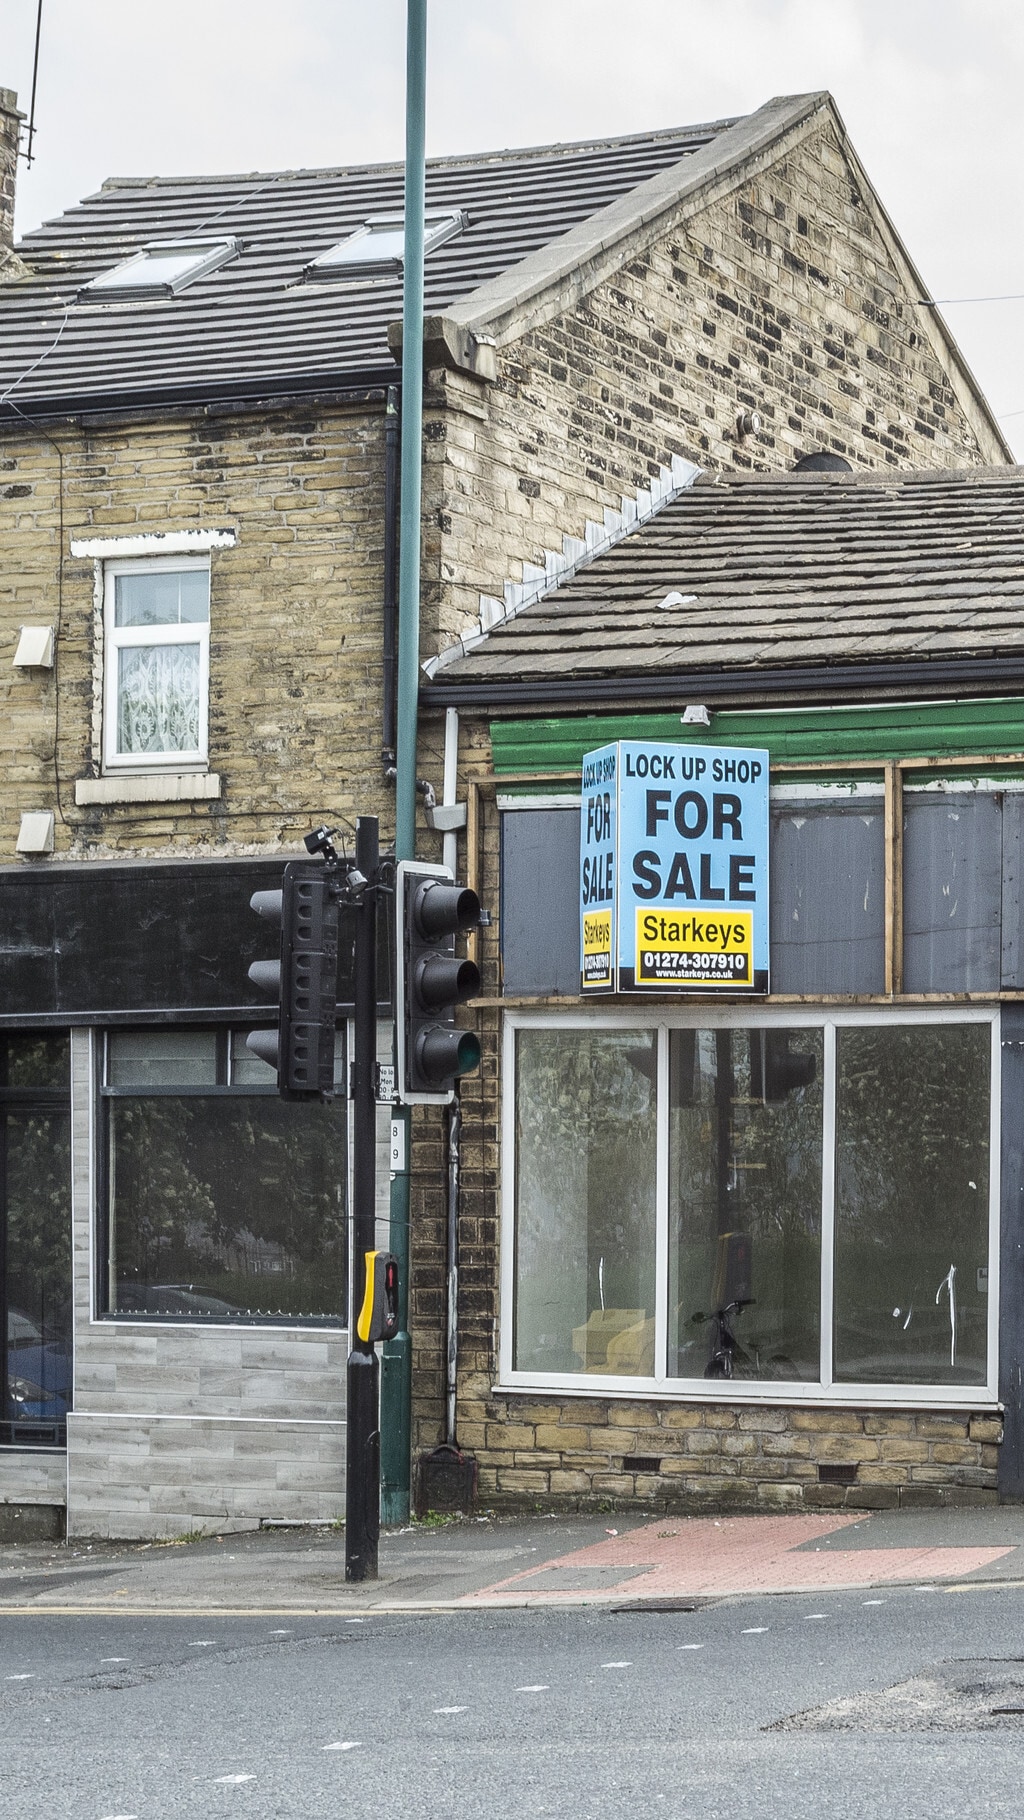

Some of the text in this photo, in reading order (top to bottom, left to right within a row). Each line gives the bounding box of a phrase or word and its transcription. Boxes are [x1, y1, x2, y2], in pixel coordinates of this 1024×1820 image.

[583, 764, 596, 789] LOCK
[625, 753, 762, 783] LOCK UP SHOP
[587, 792, 610, 844] FOR
[645, 789, 743, 840] FOR
[582, 852, 613, 906] SALE
[632, 850, 756, 902] SALE
[584, 919, 610, 949] Starkeys
[643, 915, 745, 949] Starkeys
[644, 953, 745, 969] 01274-307910
[656, 969, 733, 979] www.starkeys.co.uk
[392, 1127, 398, 1137] 8
[393, 1149, 399, 1159] 9
